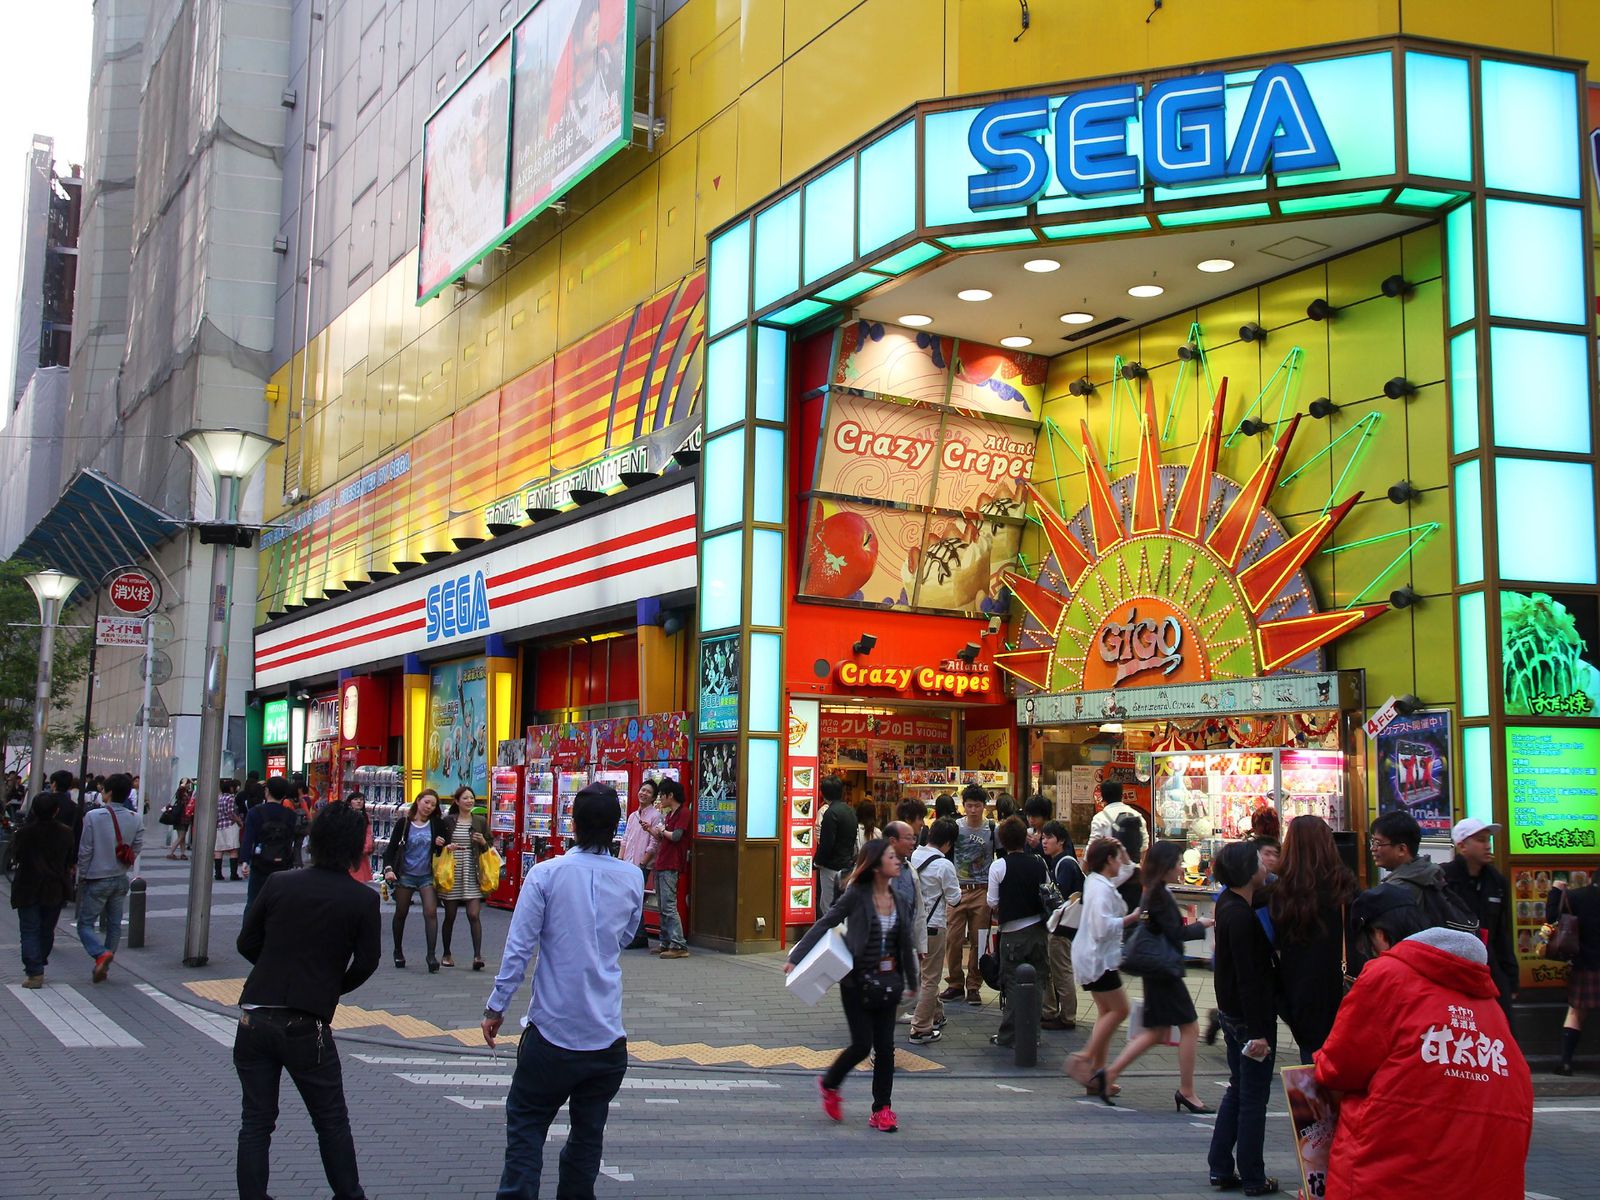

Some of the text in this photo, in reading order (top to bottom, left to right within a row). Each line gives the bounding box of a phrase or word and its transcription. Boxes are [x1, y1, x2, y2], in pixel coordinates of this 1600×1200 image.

[968, 63, 1340, 212] SEGA
[389, 452, 411, 481] SEGA
[834, 420, 1034, 483] Crazy Crepes
[486, 445, 649, 525] TOTAL ENTERTAINMENT
[114, 584, 150, 602] 消火栓
[427, 570, 490, 642] SEGA
[841, 662, 991, 696] Crazy Crepes
[947, 659, 990, 673] Atlanta
[841, 719, 913, 737] クレプの日
[1448, 1004, 1474, 1018] 手作り
[1420, 1024, 1508, 1076] 甘太郎
[1444, 1068, 1489, 1082] AMATARO
